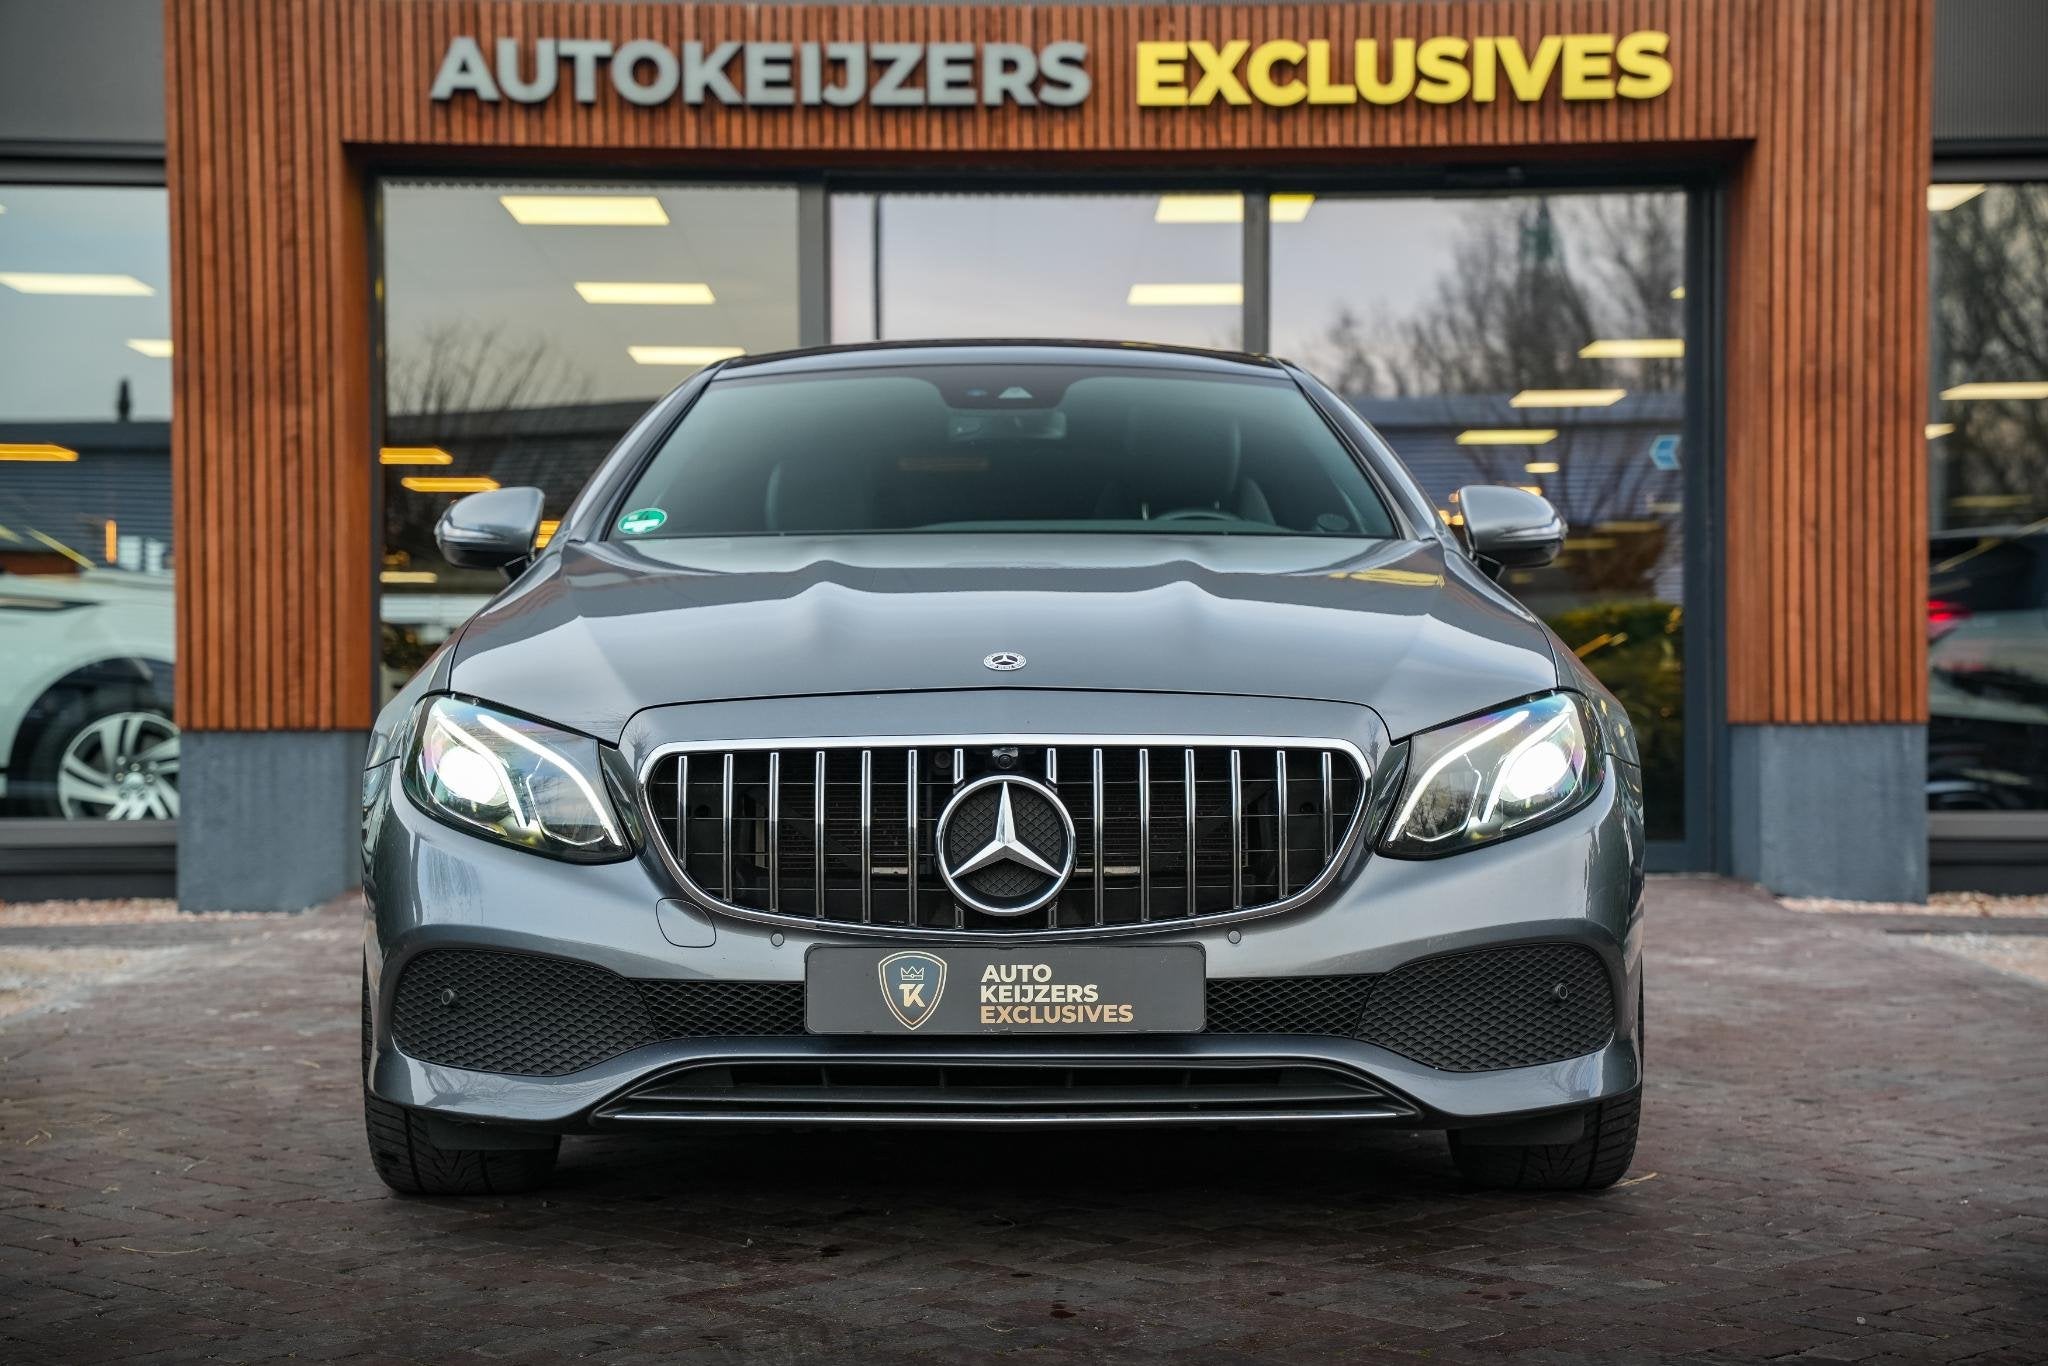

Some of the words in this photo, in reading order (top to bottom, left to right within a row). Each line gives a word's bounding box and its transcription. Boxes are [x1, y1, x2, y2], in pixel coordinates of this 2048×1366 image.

[429, 36, 1093, 107] AUTOKEIJZERS
[1136, 31, 1674, 106] EXCLUSIVES
[980, 964, 1052, 983] AUTO
[980, 985, 1099, 1003] KEIJZERS
[980, 1005, 1134, 1024] EXCLUSIVES
